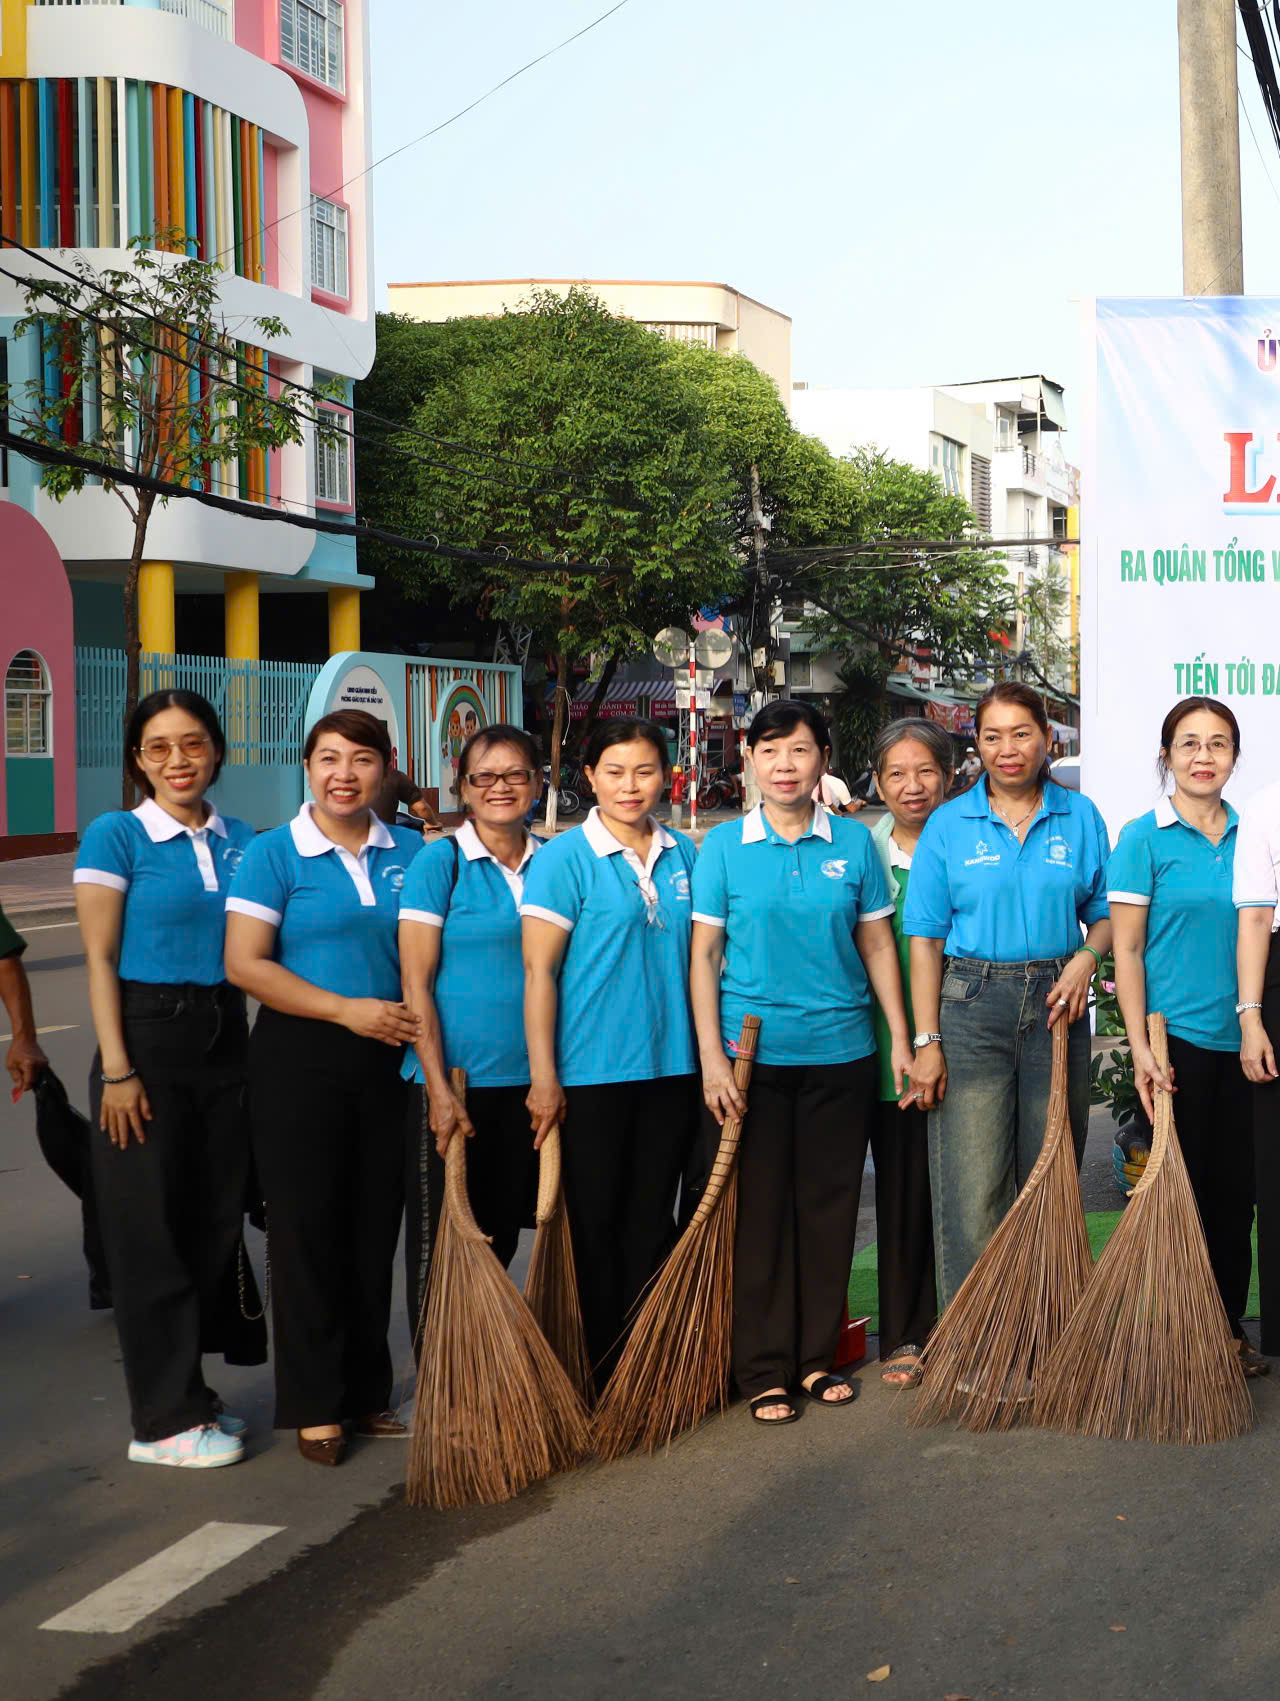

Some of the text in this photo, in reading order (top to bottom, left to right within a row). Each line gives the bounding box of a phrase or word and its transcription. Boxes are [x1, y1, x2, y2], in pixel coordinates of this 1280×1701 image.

[1120, 549, 1148, 583] RA
[1152, 542, 1207, 586] QUÂN
[1212, 536, 1266, 583] TỔNG
[1173, 651, 1219, 696] TIẾN
[1224, 655, 1257, 696] TỚI
